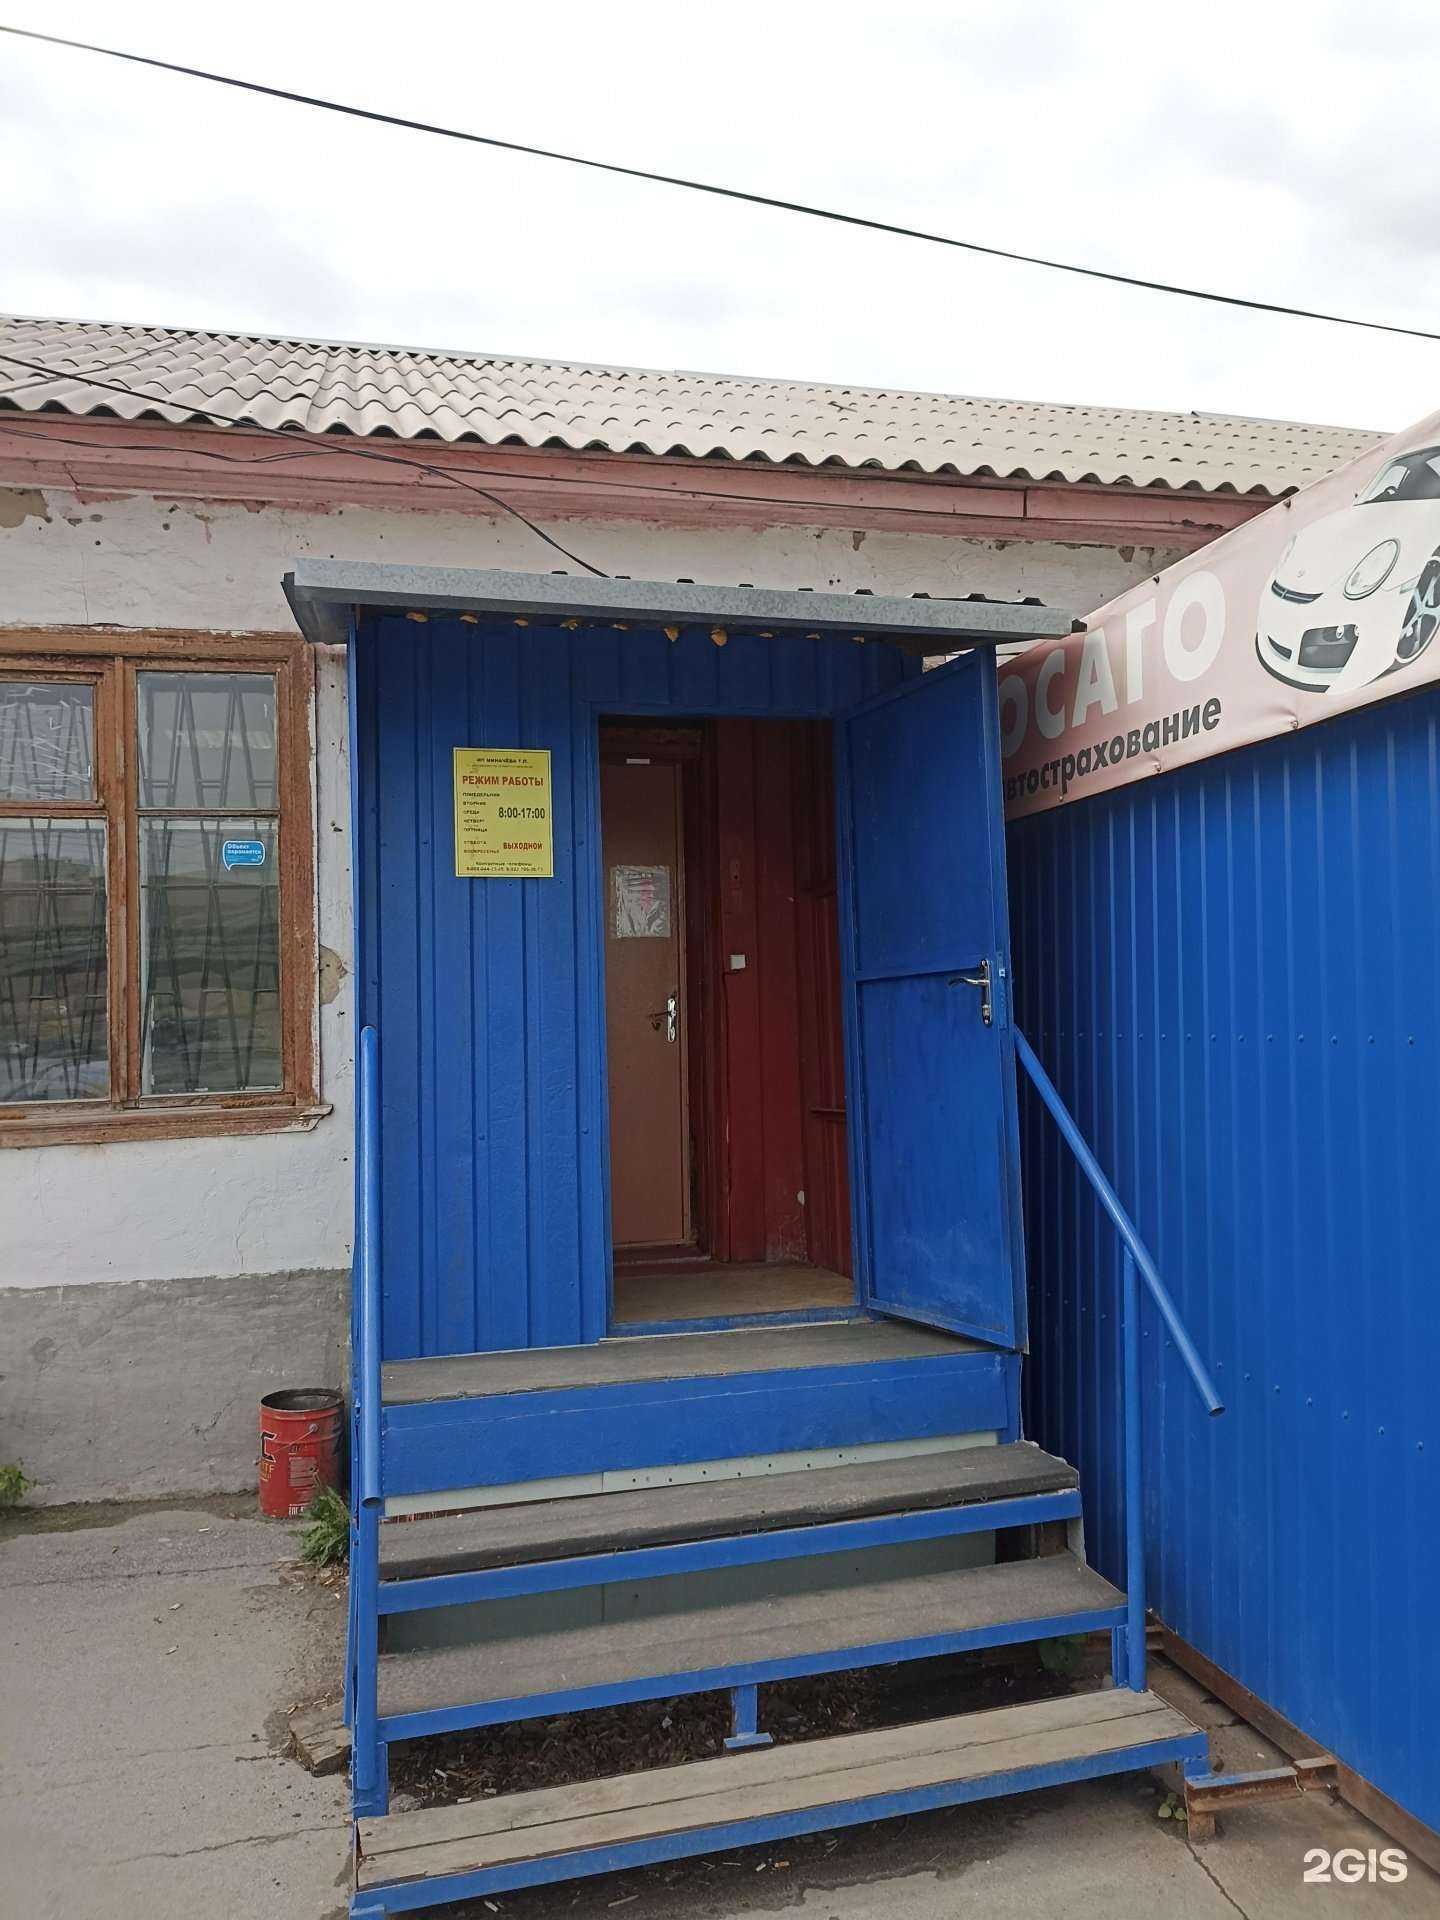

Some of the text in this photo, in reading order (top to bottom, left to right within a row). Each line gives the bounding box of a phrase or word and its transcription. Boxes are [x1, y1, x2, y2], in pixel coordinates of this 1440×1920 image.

[1000, 569, 1226, 759] ОСАГО
[1005, 697, 1222, 799] втострахование
[462, 775, 544, 786] РЕЖИМ РАБОТЫ
[498, 807, 545, 819] 8:00-17:00
[503, 841, 543, 851] ВЫХОДНОЙ
